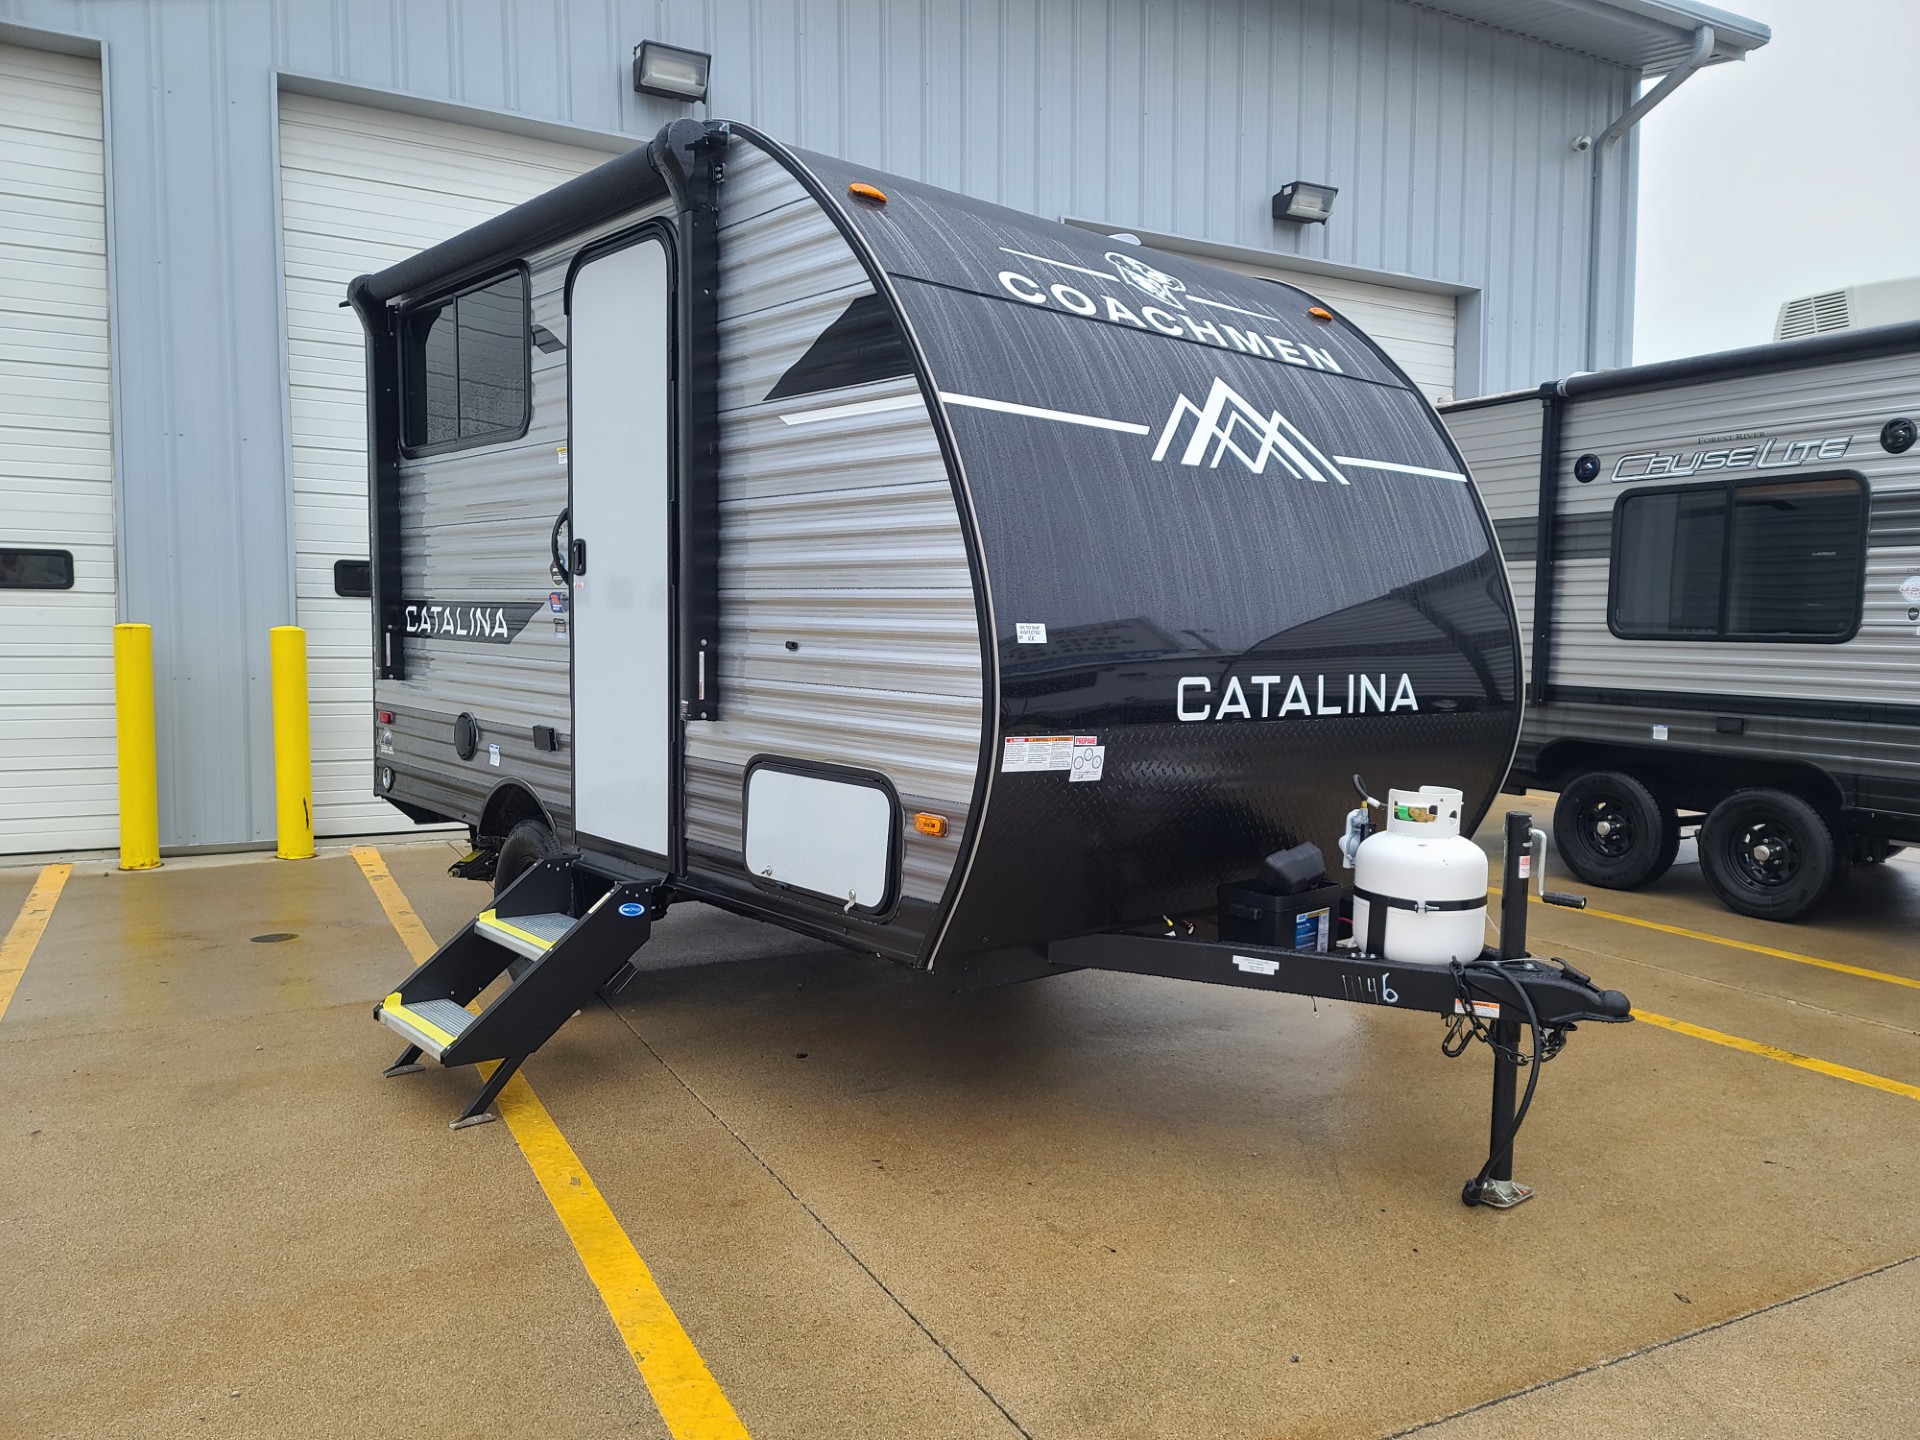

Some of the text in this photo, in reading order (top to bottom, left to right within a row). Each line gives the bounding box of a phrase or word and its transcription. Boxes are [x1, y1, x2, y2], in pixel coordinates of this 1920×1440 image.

[998, 270, 1343, 373] COACHMEN
[1698, 431, 1766, 445] FOREST RIVER
[405, 605, 508, 638] CATALINA
[1177, 673, 1419, 722] CATALINA
[1075, 737, 1096, 745] PROPANE
